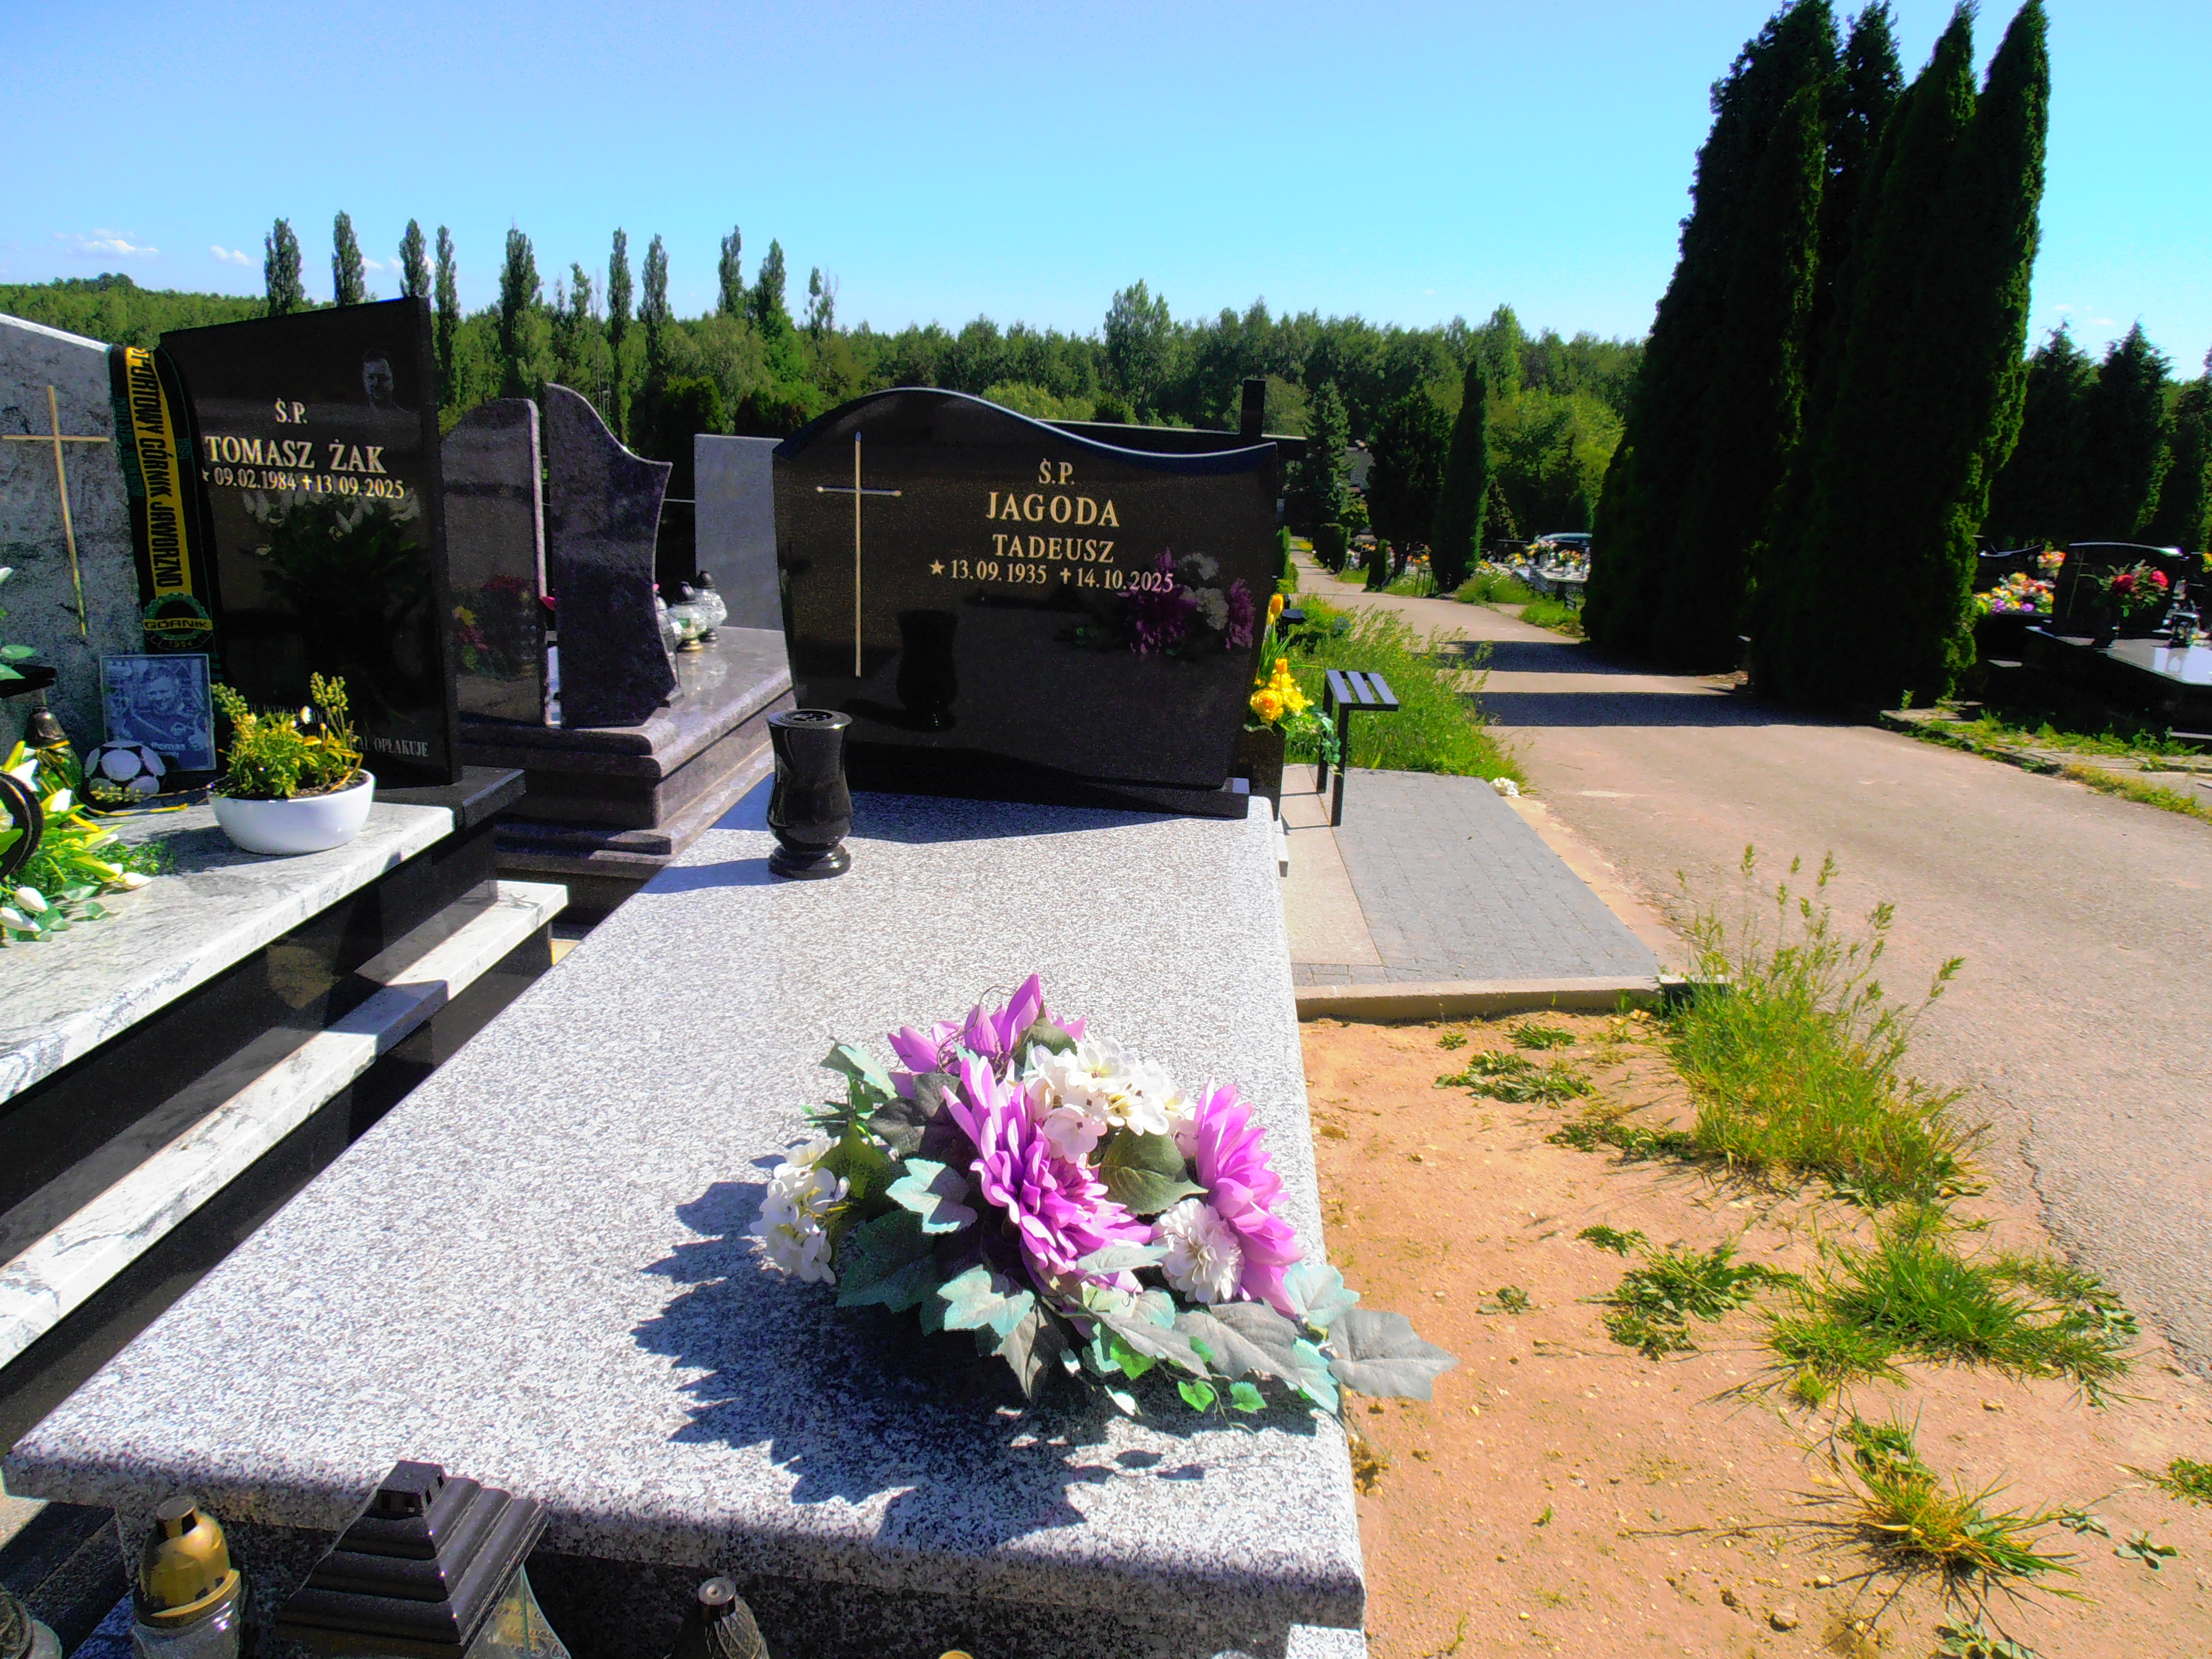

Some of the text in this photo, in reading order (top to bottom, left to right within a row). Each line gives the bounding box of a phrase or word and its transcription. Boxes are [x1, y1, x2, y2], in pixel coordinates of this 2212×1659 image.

[204, 435, 388, 474] TOMASZ ŻAK
[213, 467, 405, 499] 09.02.1984 13.09.2025
[985, 491, 1120, 528] JAGODA
[150, 501, 184, 588] JAWORZNO
[992, 533, 1115, 564] TADEUSZ
[950, 559, 1175, 593] 13.09.1935 14.10.2025
